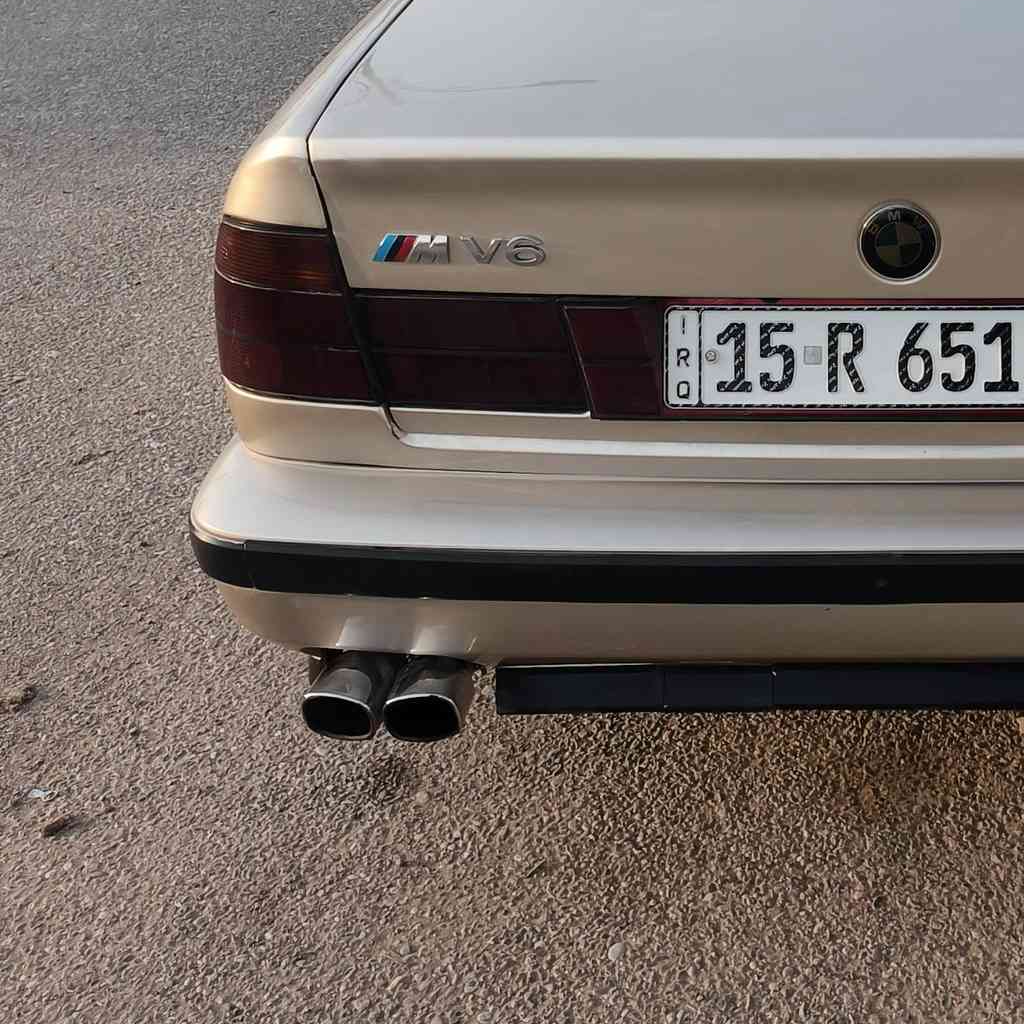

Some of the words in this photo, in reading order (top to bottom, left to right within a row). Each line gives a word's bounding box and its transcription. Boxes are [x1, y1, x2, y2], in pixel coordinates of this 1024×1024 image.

[408, 233, 450, 265] M
[459, 235, 547, 267] V6
[716, 322, 796, 393] 15
[827, 322, 865, 393] R
